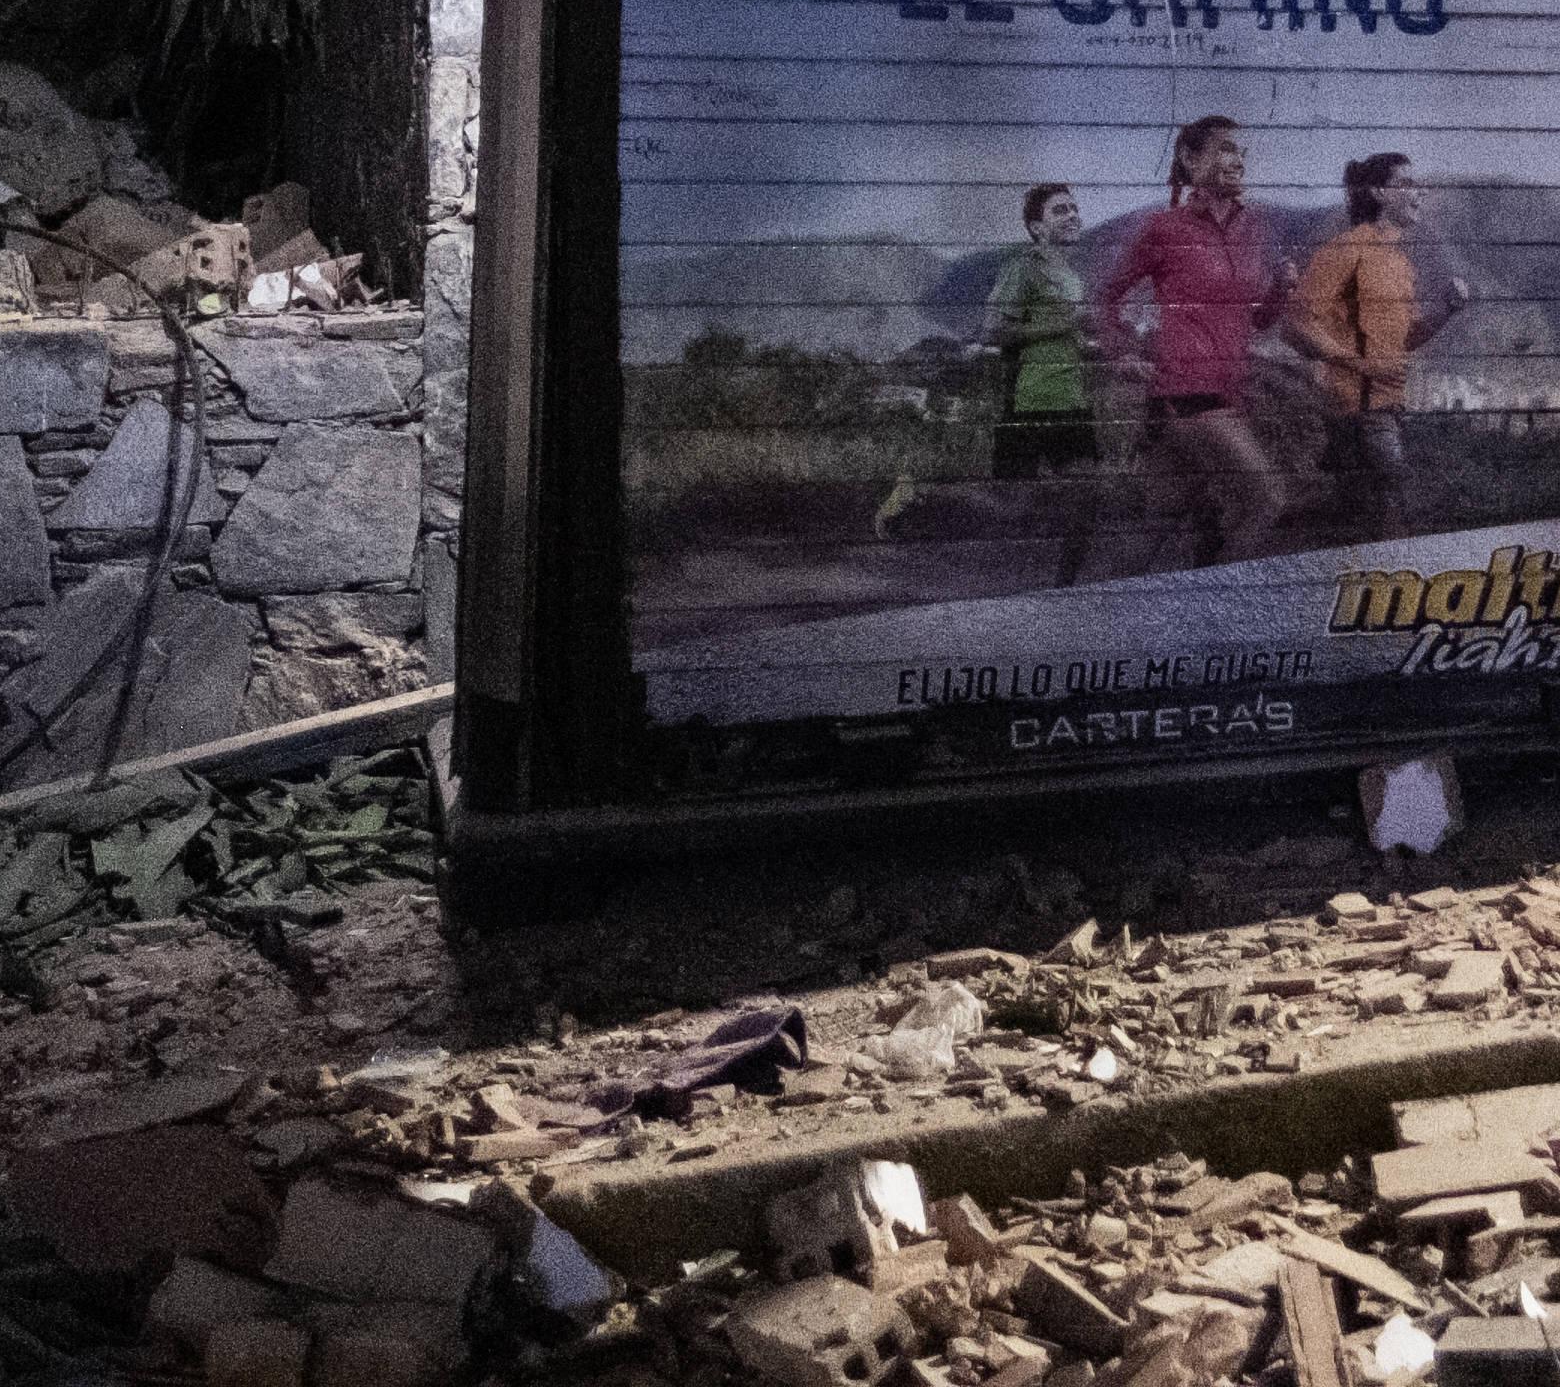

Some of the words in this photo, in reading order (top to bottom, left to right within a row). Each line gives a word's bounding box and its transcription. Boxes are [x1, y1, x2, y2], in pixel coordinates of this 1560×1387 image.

[897, 666, 999, 705] ELIJO
[1009, 664, 1052, 697] LO
[1065, 659, 1131, 695] QUE
[1143, 656, 1191, 690] ME
[1201, 650, 1313, 684] GUSTA
